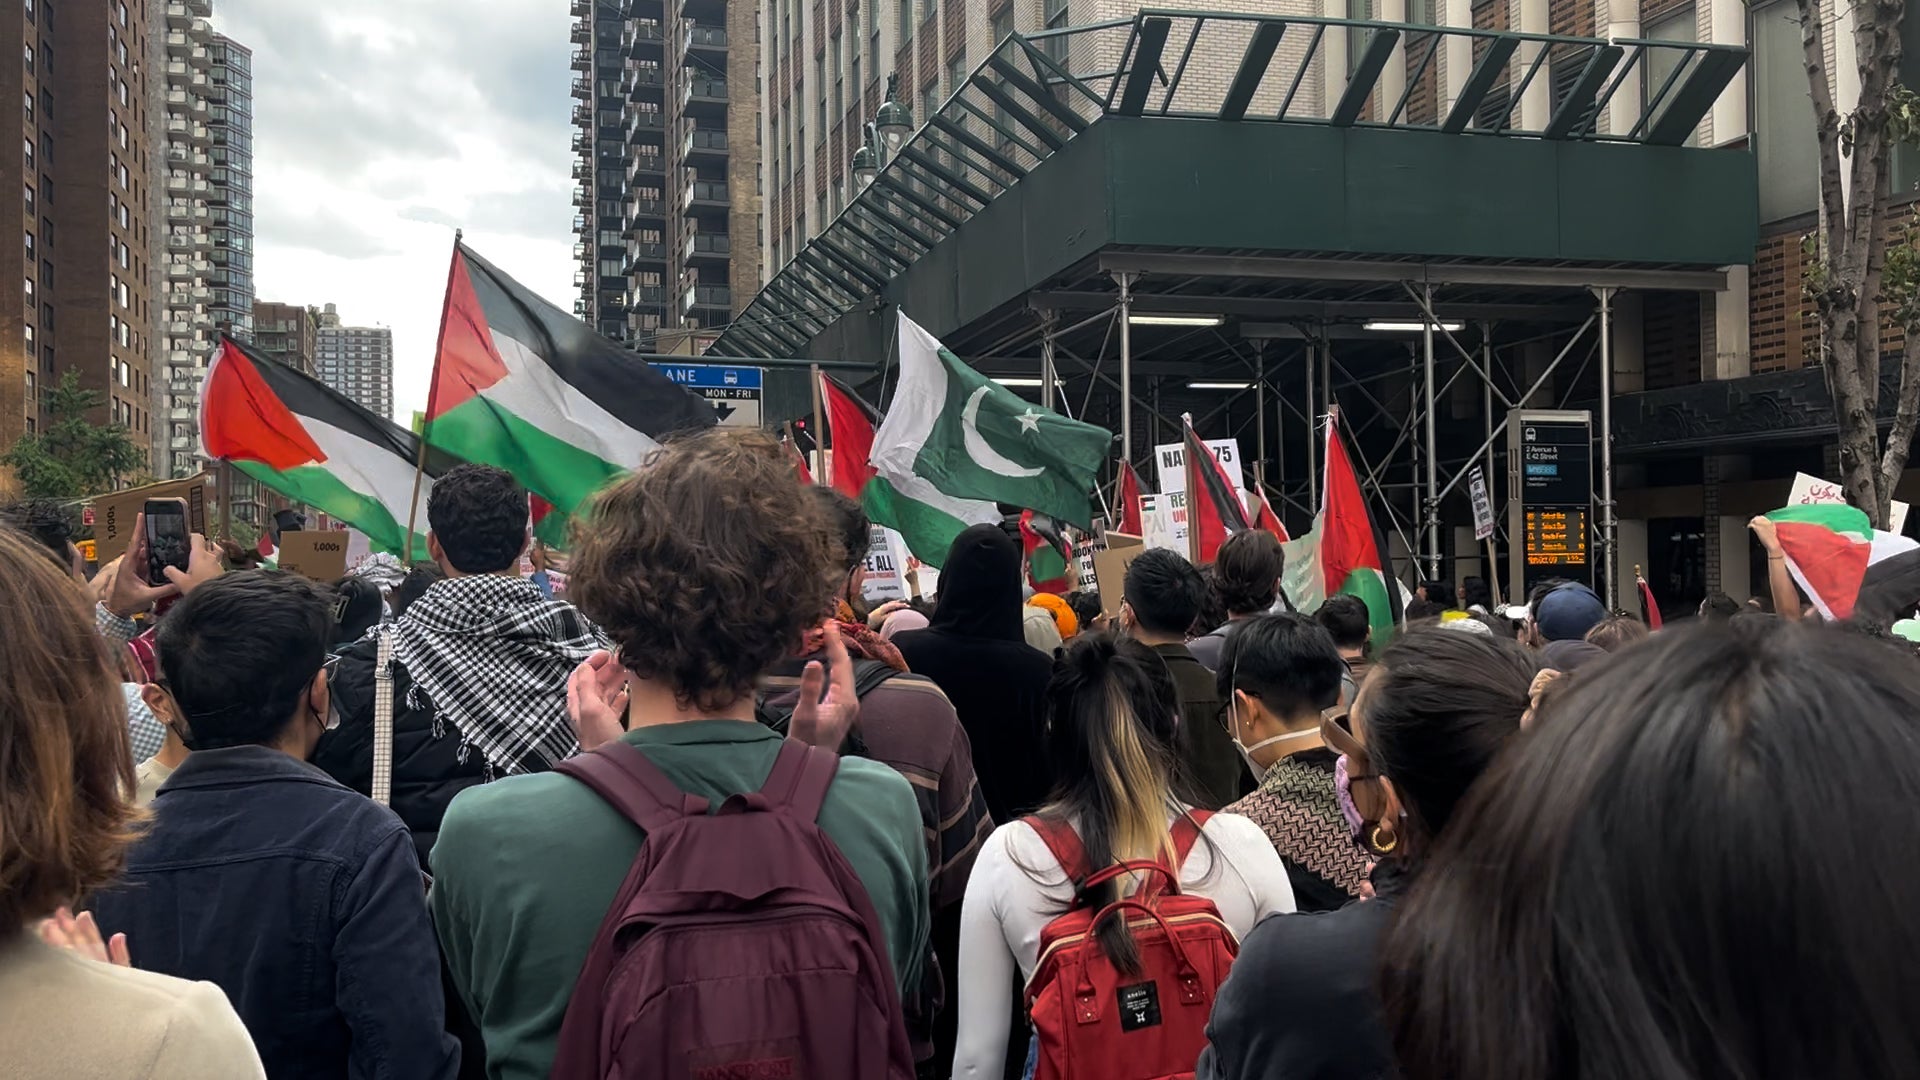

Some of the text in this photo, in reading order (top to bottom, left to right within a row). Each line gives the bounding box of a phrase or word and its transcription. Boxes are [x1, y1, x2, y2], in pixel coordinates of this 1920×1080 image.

[666, 369, 697, 382] ANE
[705, 389, 727, 398] MON
[736, 390, 752, 398] FRI
[1162, 446, 1232, 468] NA 75
[1170, 493, 1185, 508] RE
[313, 542, 340, 551] 1,000s
[876, 555, 895, 571] ALL
[1082, 561, 1093, 570] FO
